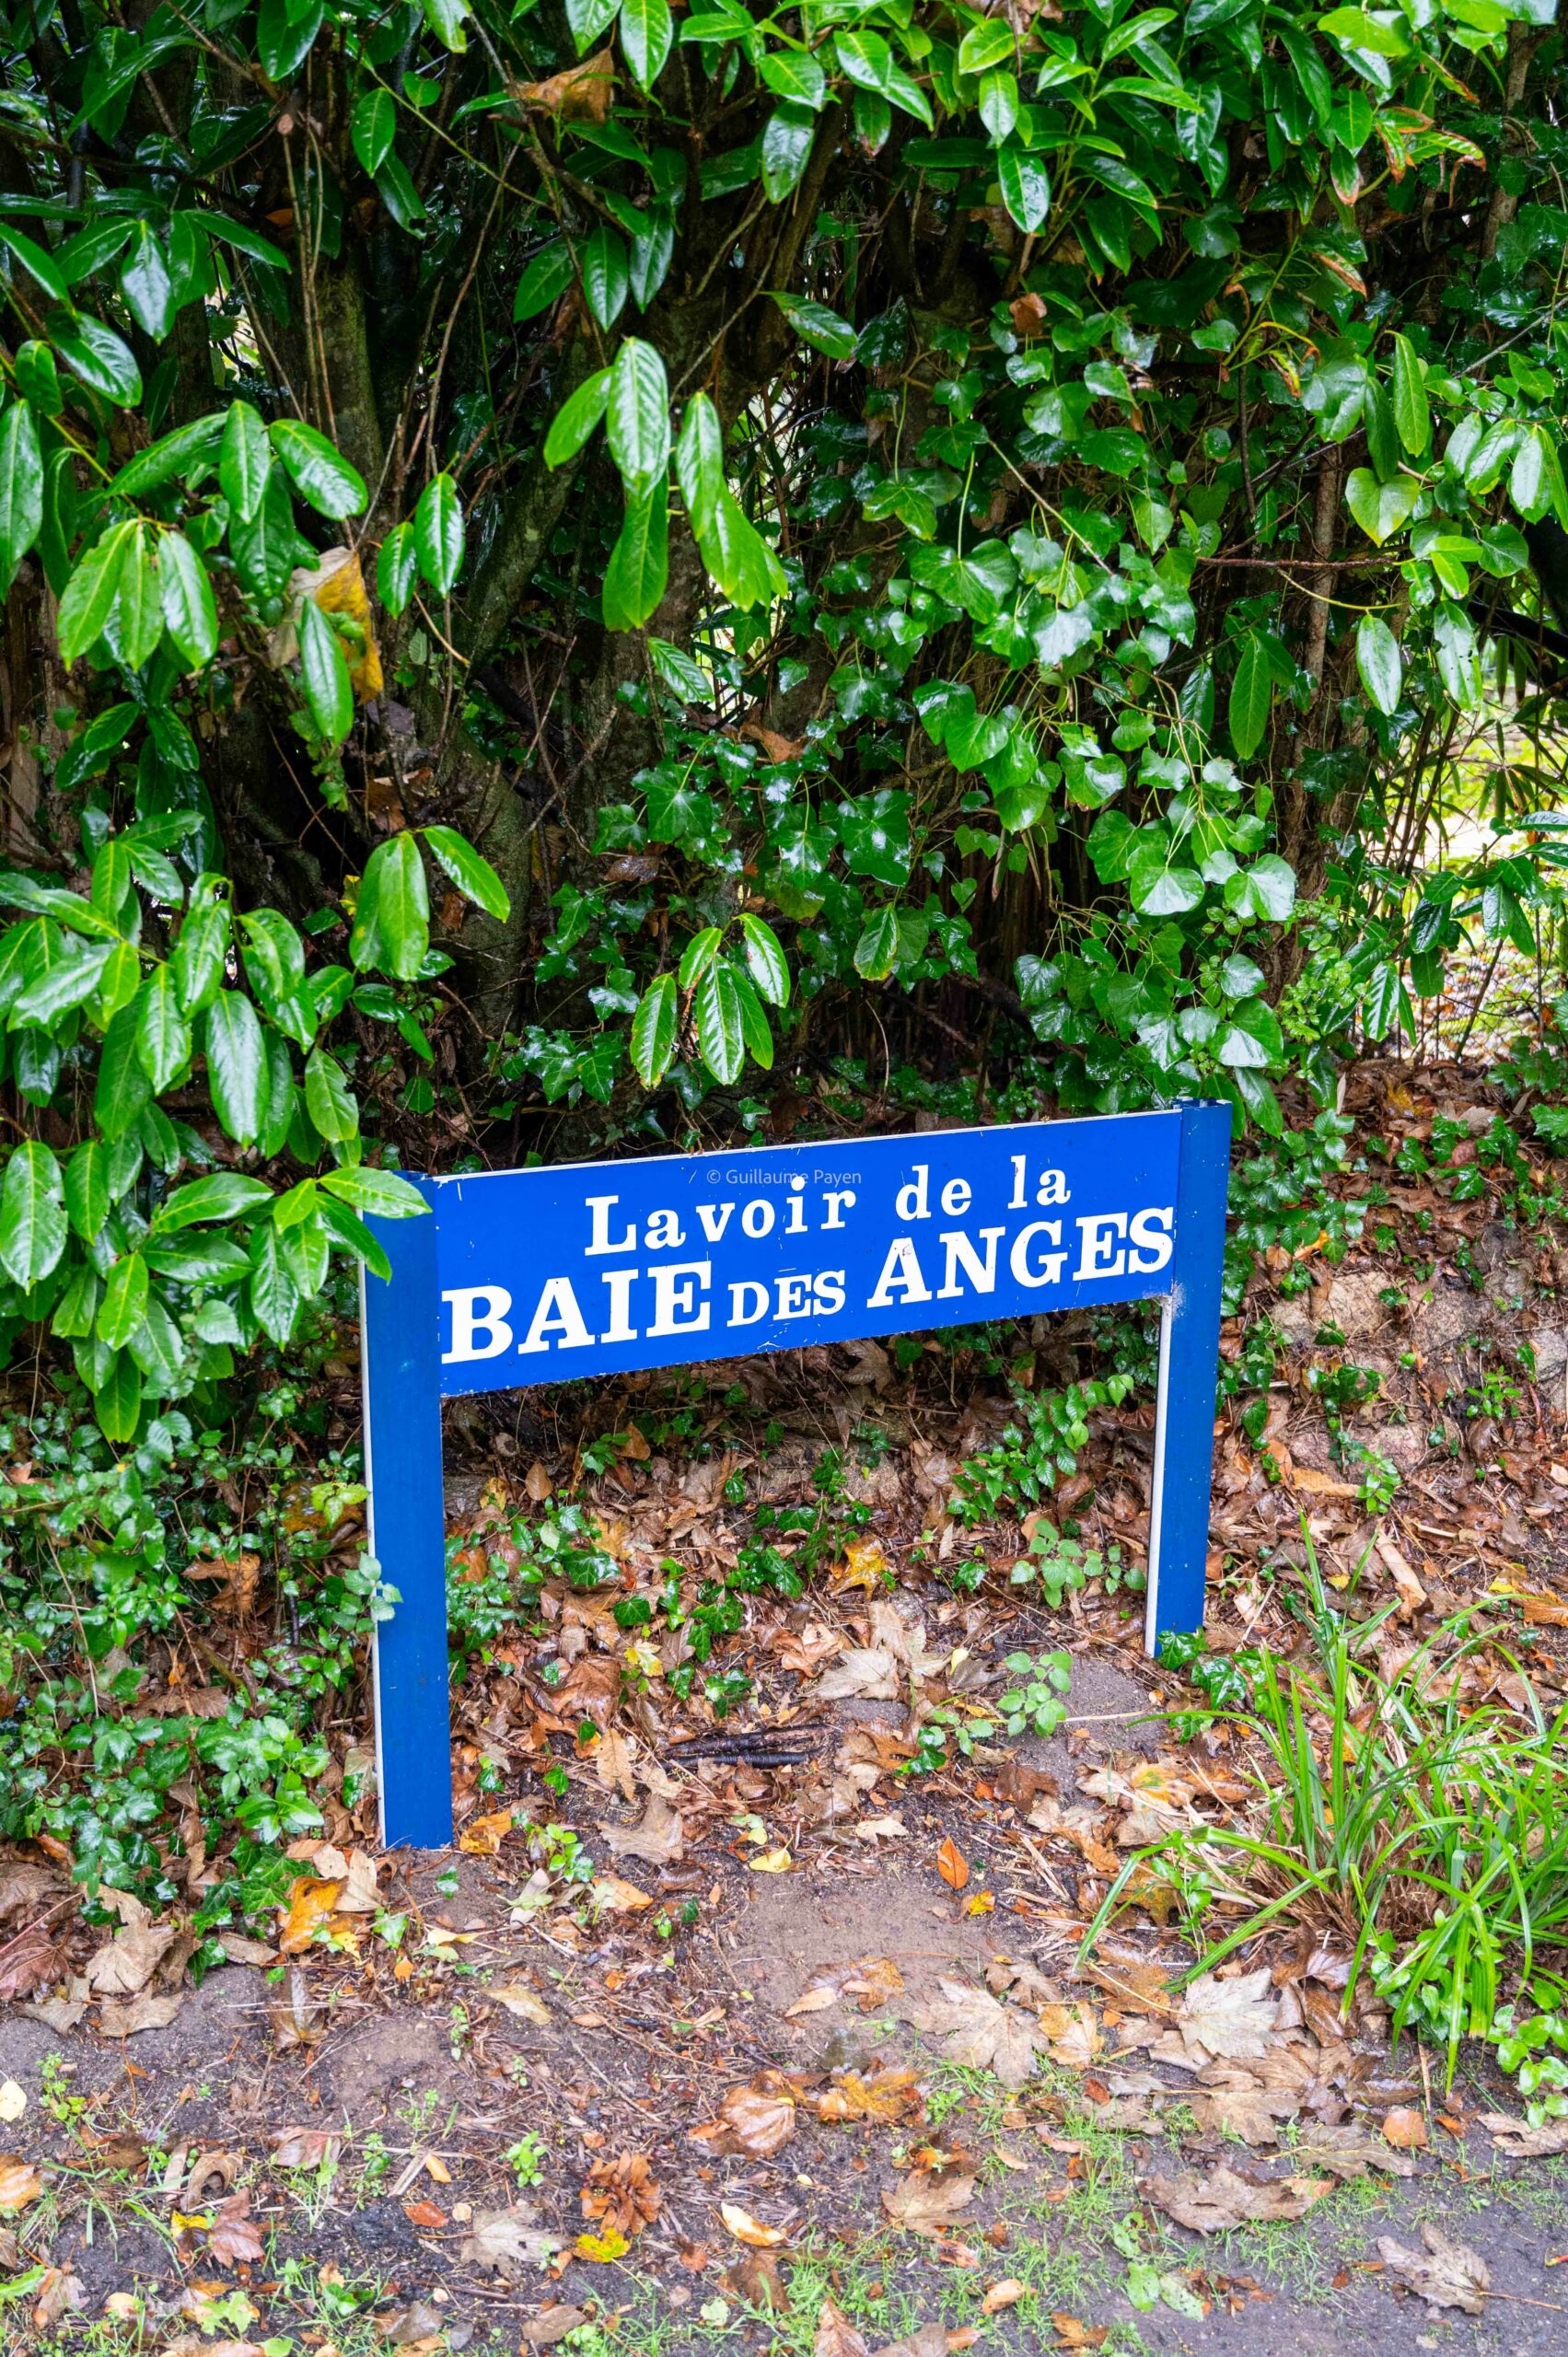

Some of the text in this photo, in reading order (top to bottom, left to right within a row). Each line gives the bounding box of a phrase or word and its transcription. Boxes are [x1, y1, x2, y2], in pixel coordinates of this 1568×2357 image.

[584, 1155, 1072, 1256] Lavoir de la
[441, 1206, 1174, 1364] BAIE DES ANGES
